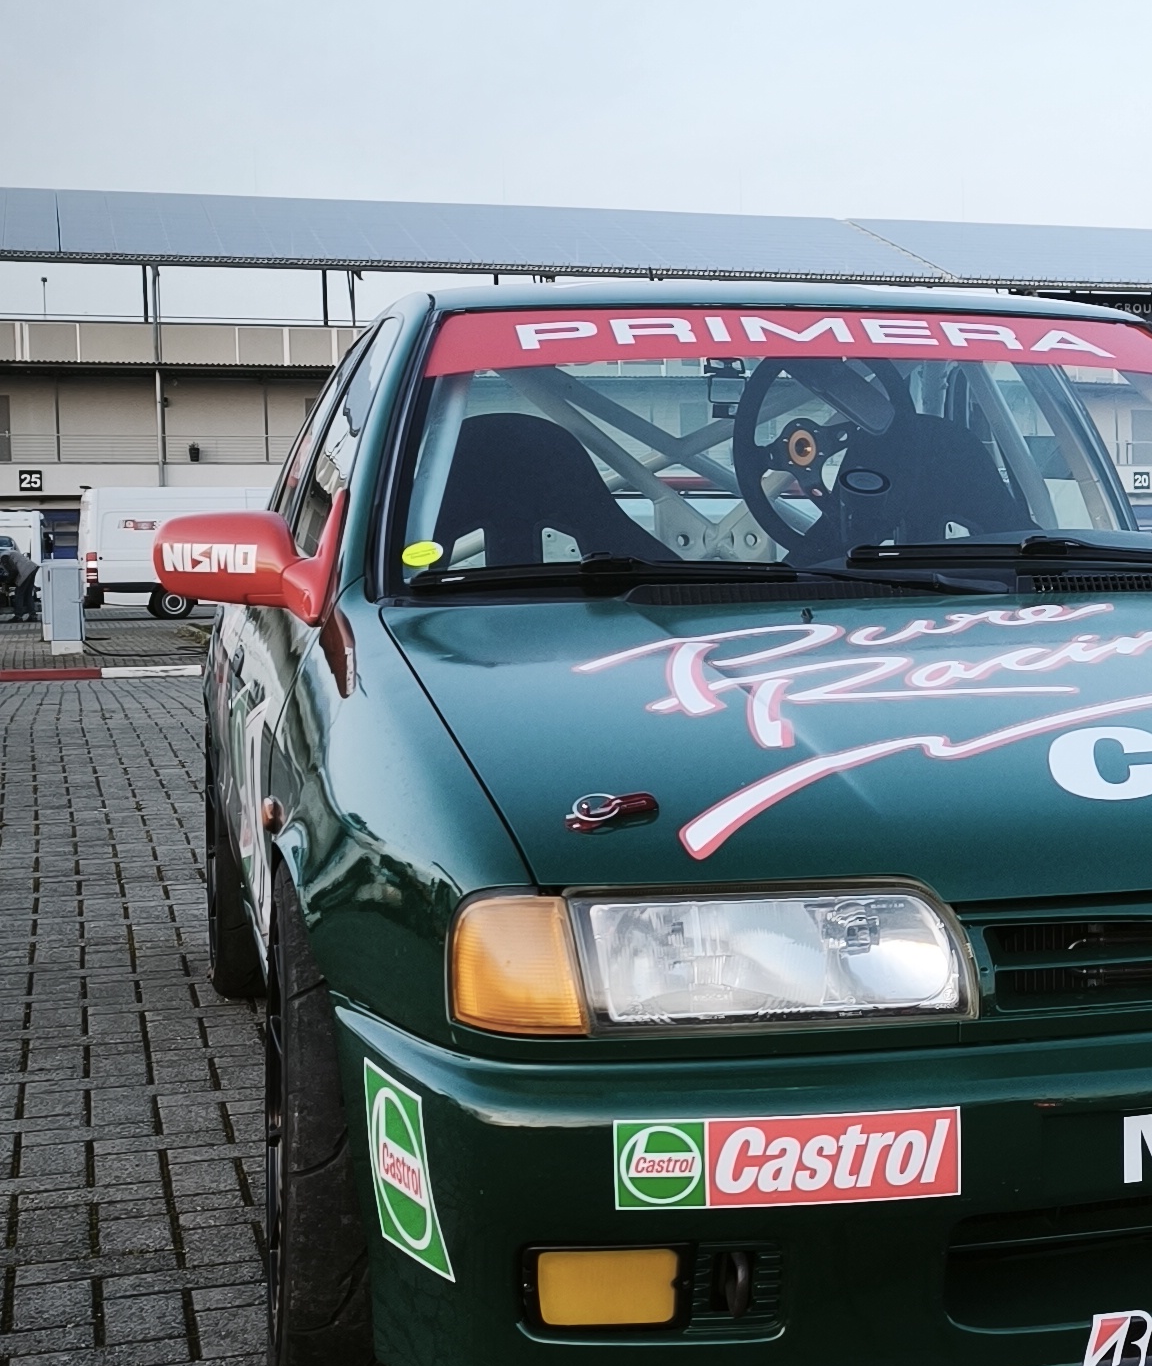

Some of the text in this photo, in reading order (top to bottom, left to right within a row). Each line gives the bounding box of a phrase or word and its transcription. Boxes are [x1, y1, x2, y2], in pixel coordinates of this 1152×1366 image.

[515, 316, 1117, 358] PRIMERA
[20, 473, 41, 488] 25
[1134, 474, 1149, 487] 20
[162, 542, 258, 574] NISMO
[571, 602, 1115, 717] Pure
[382, 1142, 423, 1199] Castrol
[634, 1156, 695, 1174] Castrol
[714, 1118, 951, 1194] Castrol
